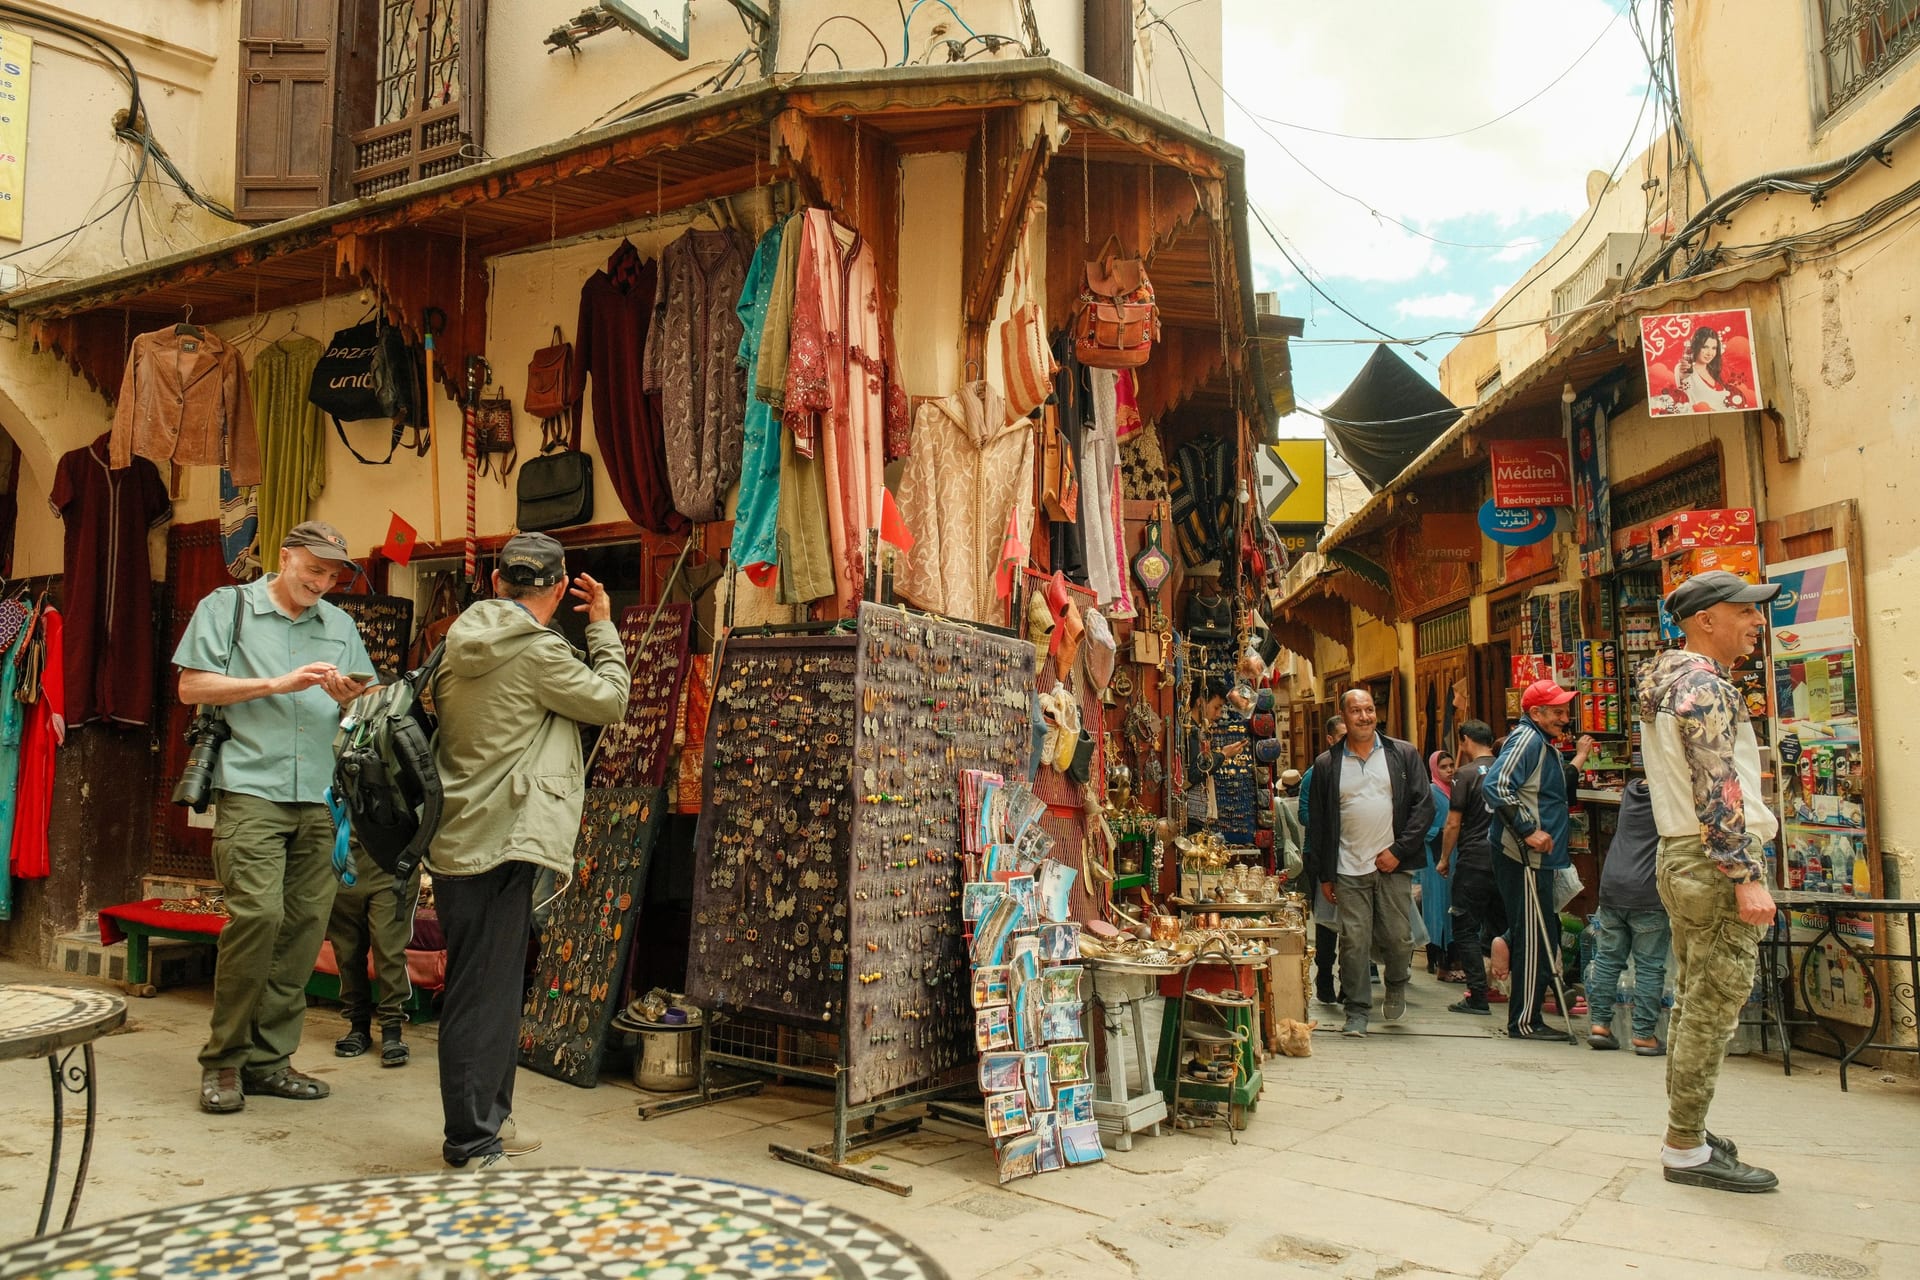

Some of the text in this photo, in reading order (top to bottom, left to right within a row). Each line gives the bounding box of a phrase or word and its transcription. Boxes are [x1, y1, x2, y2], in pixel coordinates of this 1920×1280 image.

[1497, 464, 1556, 480] Méditel
[1503, 494, 1564, 505] Rechargez ici
[1495, 509, 1529, 518] اتصالات
[1500, 517, 1529, 527] المغرب
[1427, 547, 1471, 558] orange
[1800, 591, 1820, 600] inwi
[1801, 914, 1857, 935] Cold inks
